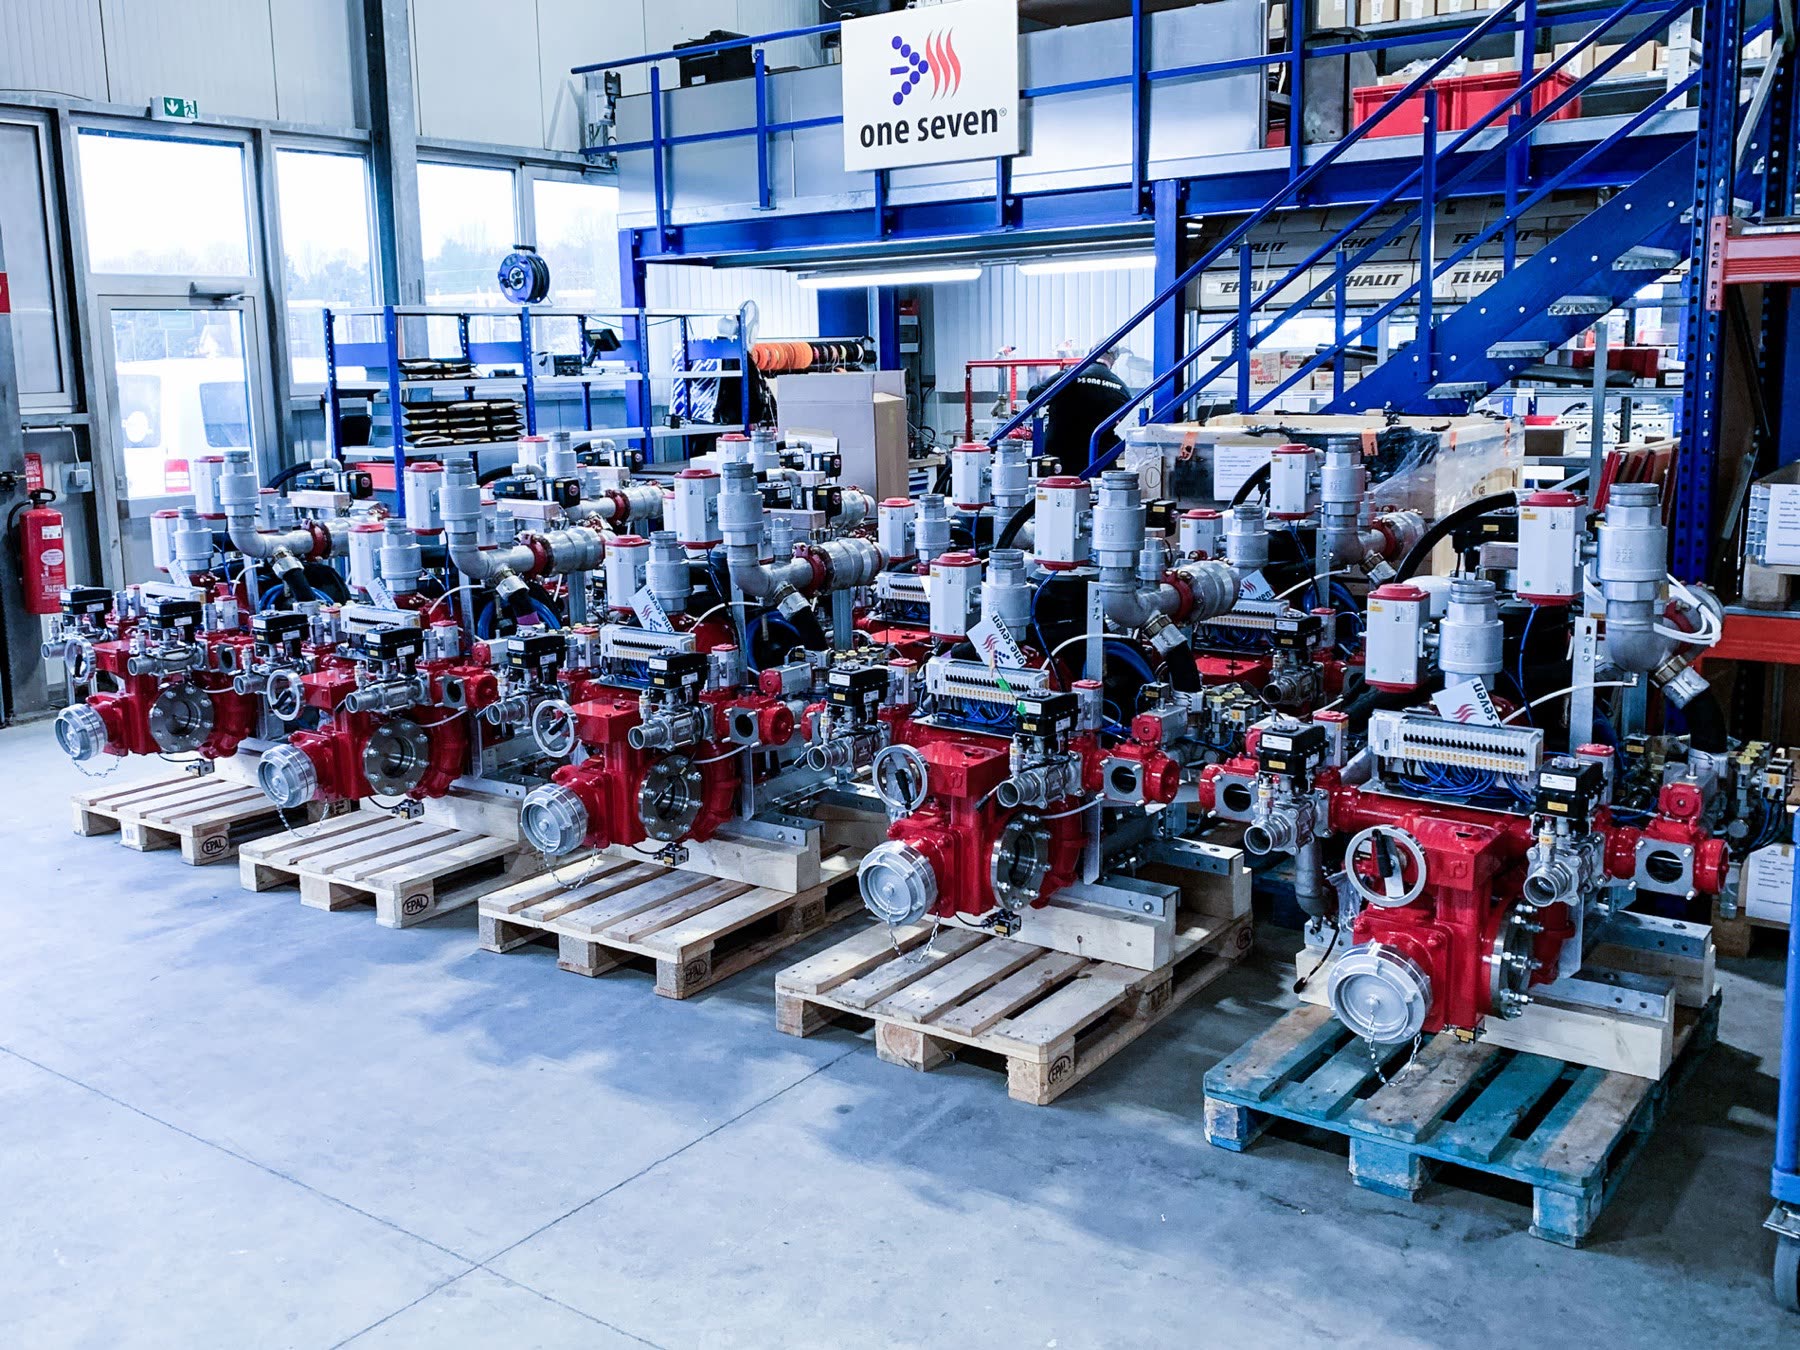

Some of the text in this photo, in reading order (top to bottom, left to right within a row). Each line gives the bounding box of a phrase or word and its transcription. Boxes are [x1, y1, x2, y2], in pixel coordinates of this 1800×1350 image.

[860, 119, 909, 148] one
[1086, 377, 1122, 390] one seven
[646, 588, 673, 633] one seven
[992, 615, 1025, 665] one seven
[1472, 682, 1498, 721] seven
[205, 839, 224, 852] EPAL
[406, 897, 426, 912] EPAL
